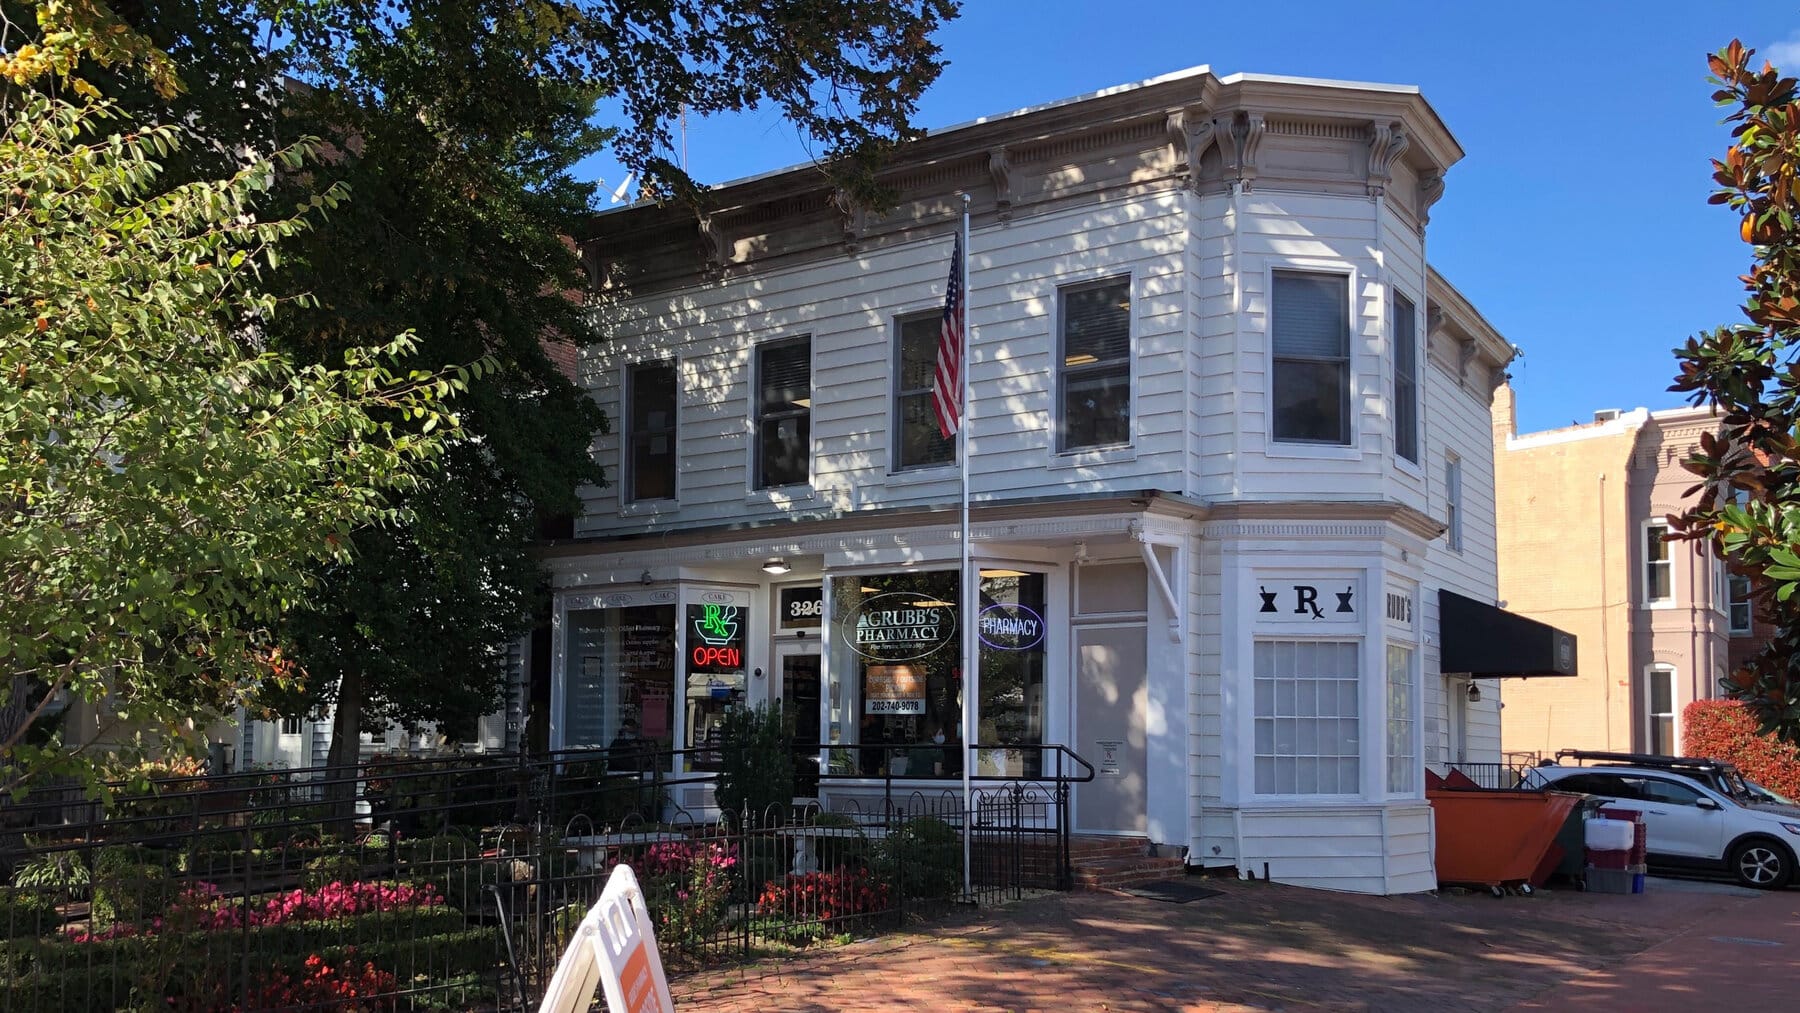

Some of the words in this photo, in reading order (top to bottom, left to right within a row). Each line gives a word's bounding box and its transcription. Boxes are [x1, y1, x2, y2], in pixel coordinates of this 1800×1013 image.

[791, 600, 822, 617] 326
[868, 608, 940, 627] GRUBB'S
[1386, 592, 1412, 624] RUBB'S
[856, 627, 940, 642] PHARMACY
[983, 617, 1038, 637] PHARMACY
[693, 646, 739, 667] OPEN
[872, 701, 919, 711] 202-740-9078
